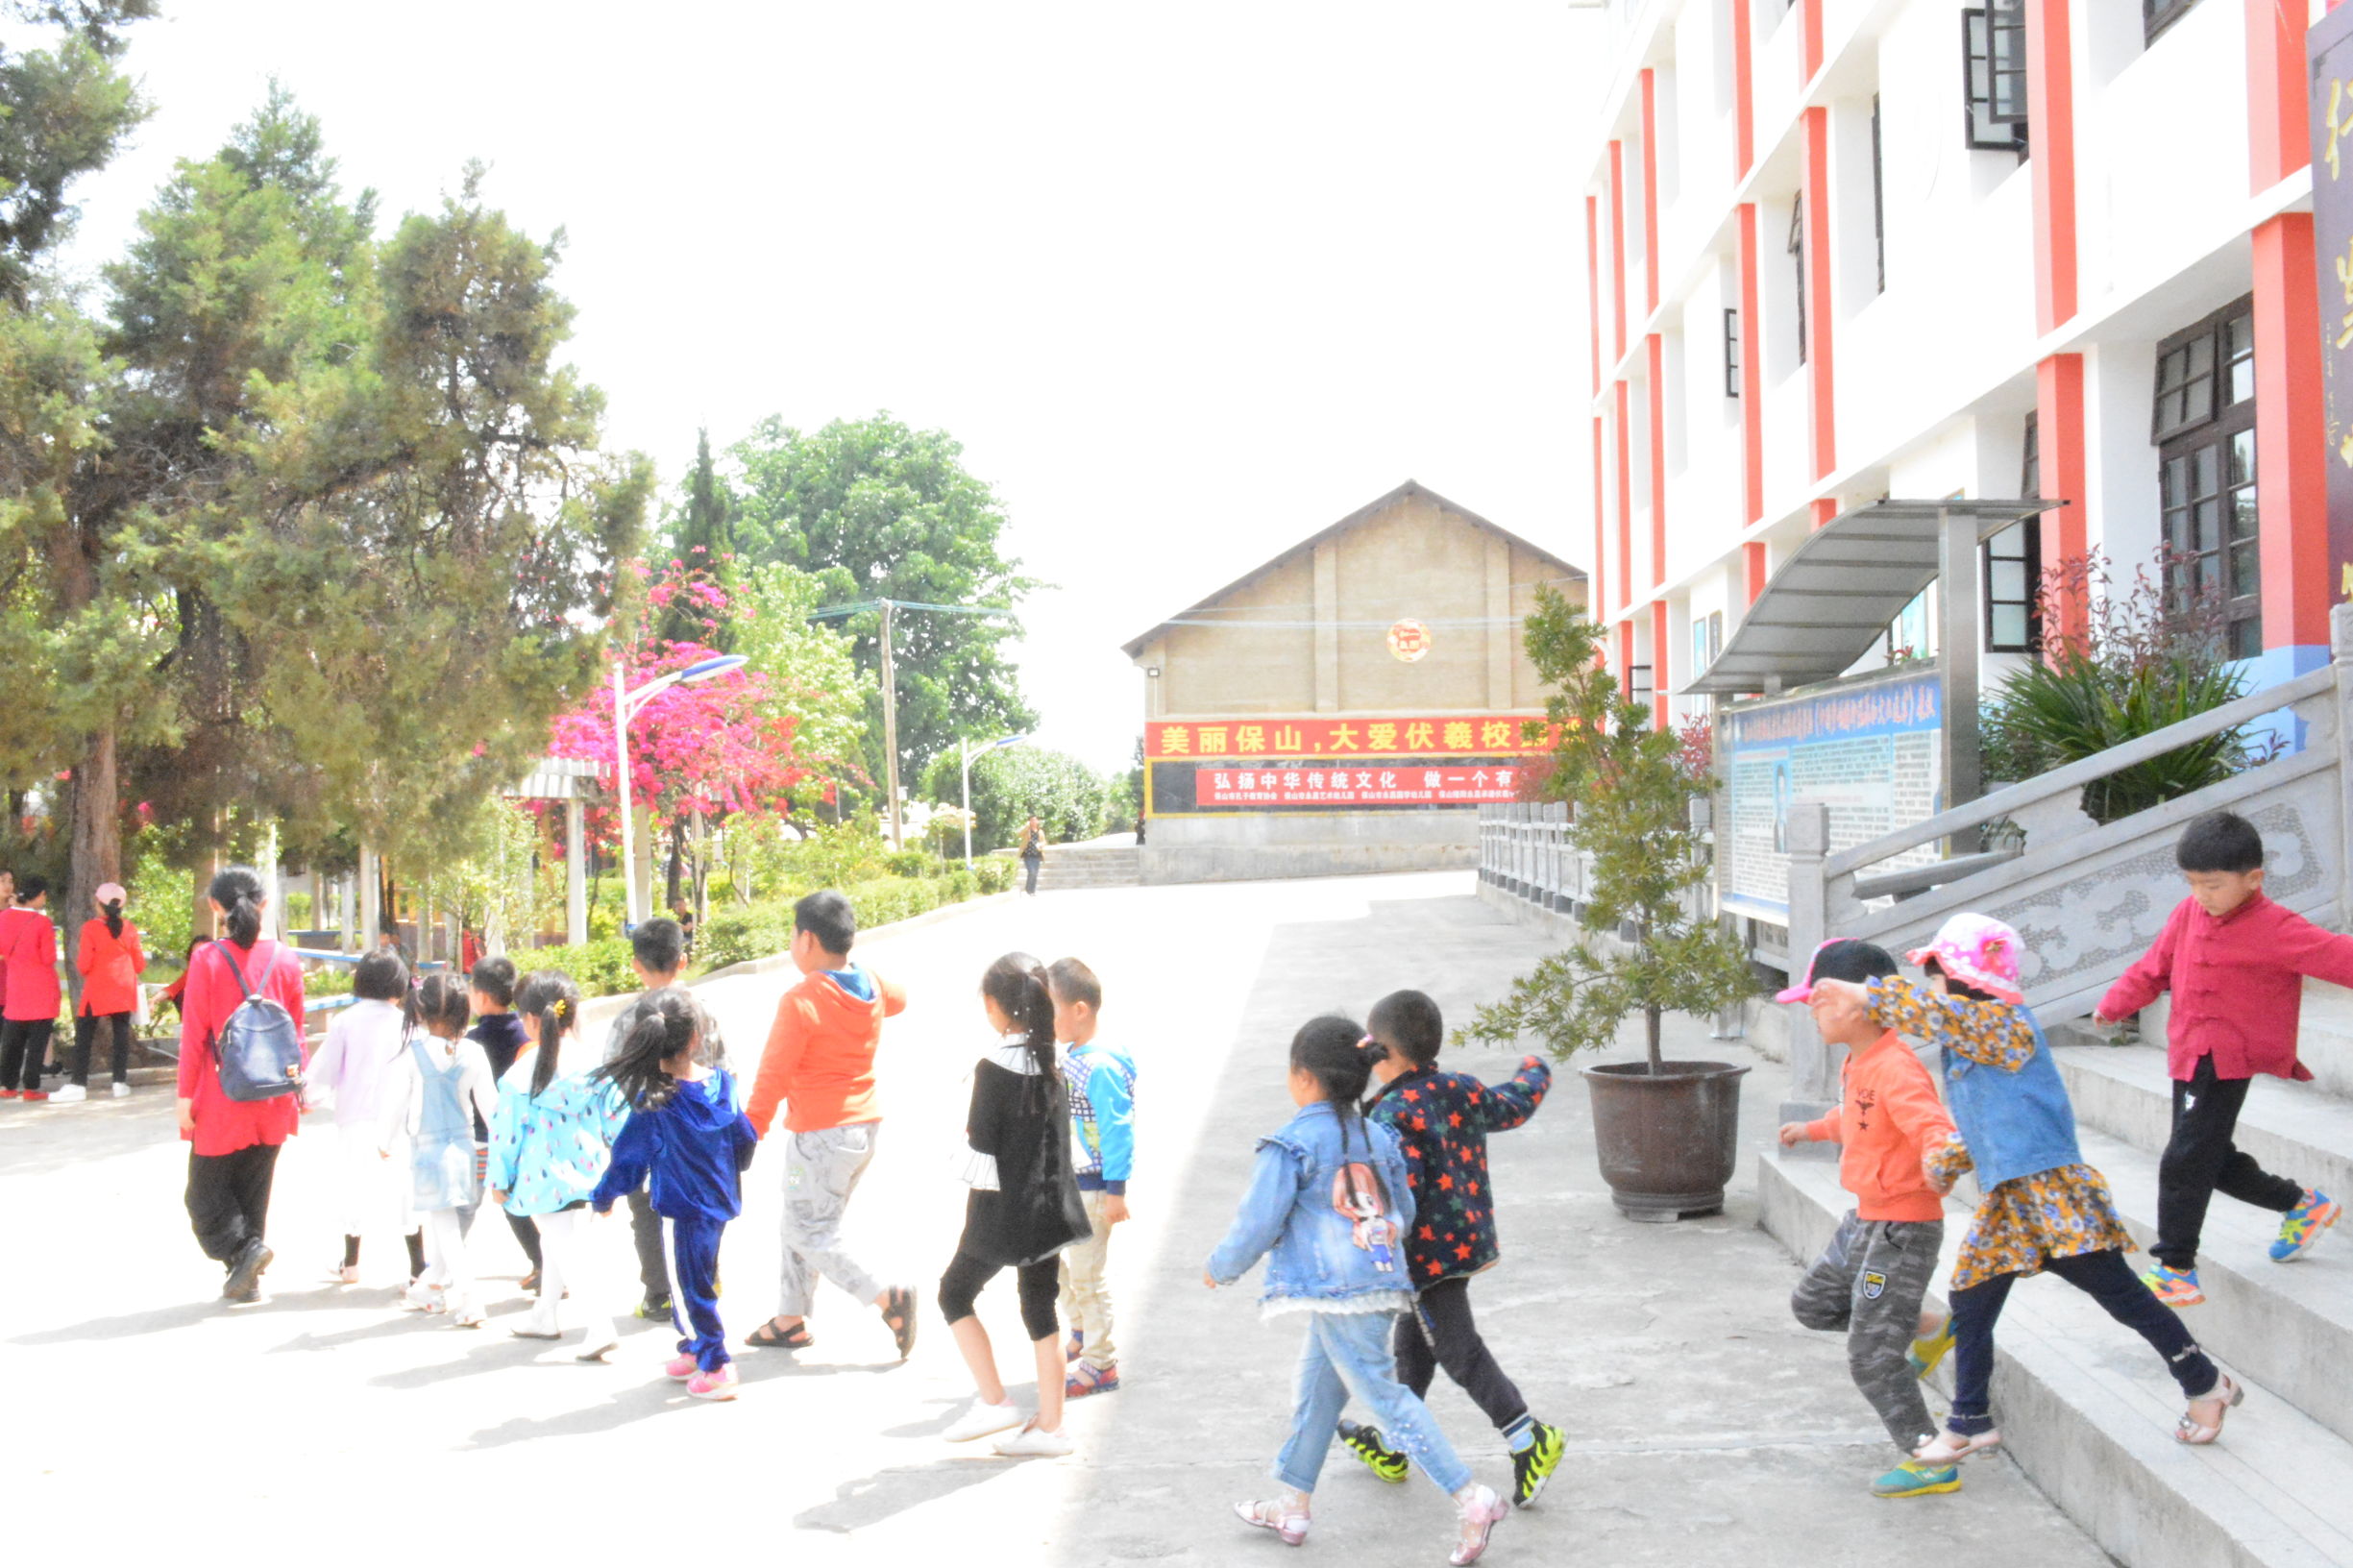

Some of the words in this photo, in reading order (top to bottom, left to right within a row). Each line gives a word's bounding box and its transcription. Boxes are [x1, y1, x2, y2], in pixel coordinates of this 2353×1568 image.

[1213, 771, 1397, 791] 弘扬中华传统文化
